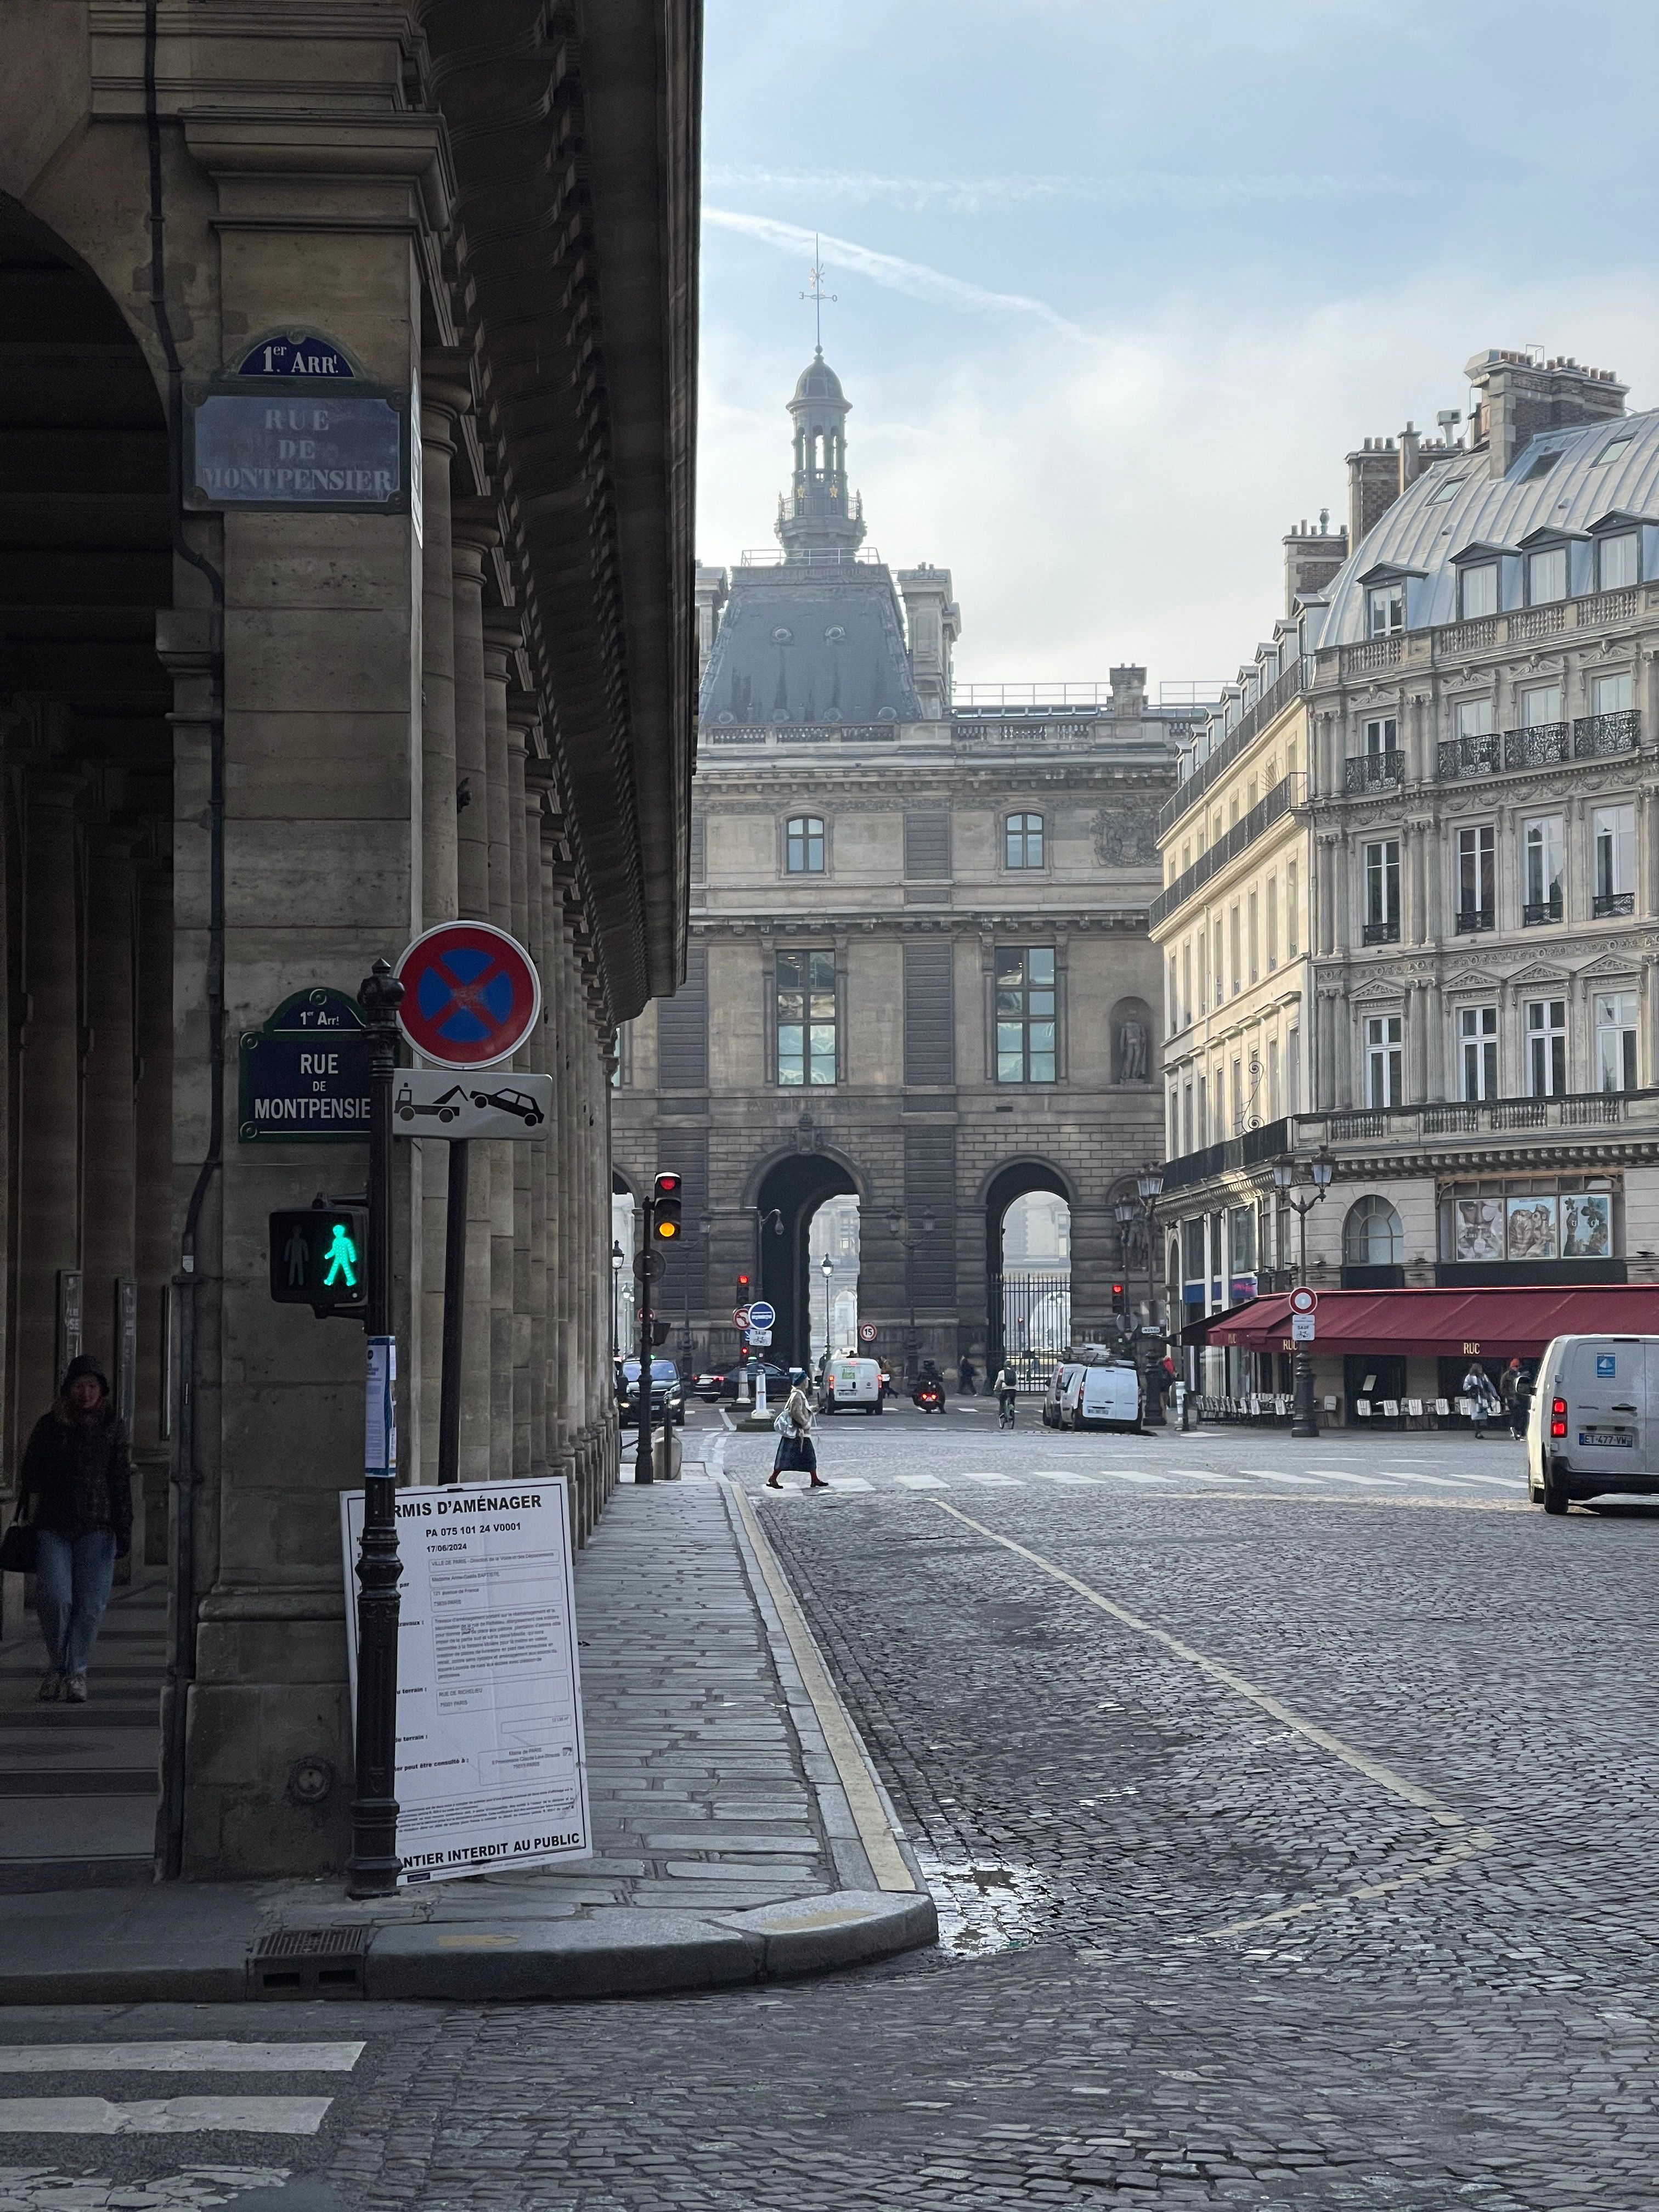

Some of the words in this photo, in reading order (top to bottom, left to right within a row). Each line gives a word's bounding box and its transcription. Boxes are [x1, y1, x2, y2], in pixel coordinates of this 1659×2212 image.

[265, 409, 329, 431] RUE
[279, 439, 316, 460] DE
[202, 467, 392, 491] MONTPENSIER
[301, 1054, 338, 1074] RUE
[313, 1081, 326, 1092] DE
[255, 1098, 371, 1119] MONTPENSIE
[1283, 1339, 1298, 1350] RUC
[1464, 1342, 1480, 1354] RUC
[394, 1503, 432, 1518] RMIS
[437, 1494, 541, 1515] D'AMÉNAGER
[426, 1529, 438, 1537] PA
[441, 1527, 458, 1536] 075
[460, 1526, 476, 1534] 101
[479, 1525, 490, 1533] 24
[493, 1522, 521, 1532] V0001
[427, 1543, 467, 1553] 17/06/2024
[434, 1758, 460, 1767] consulté
[399, 1853, 444, 1868] NTIER
[448, 1843, 508, 1861] INTERDIT
[514, 1839, 531, 1852] AU
[534, 1833, 580, 1849] PUBLIC
